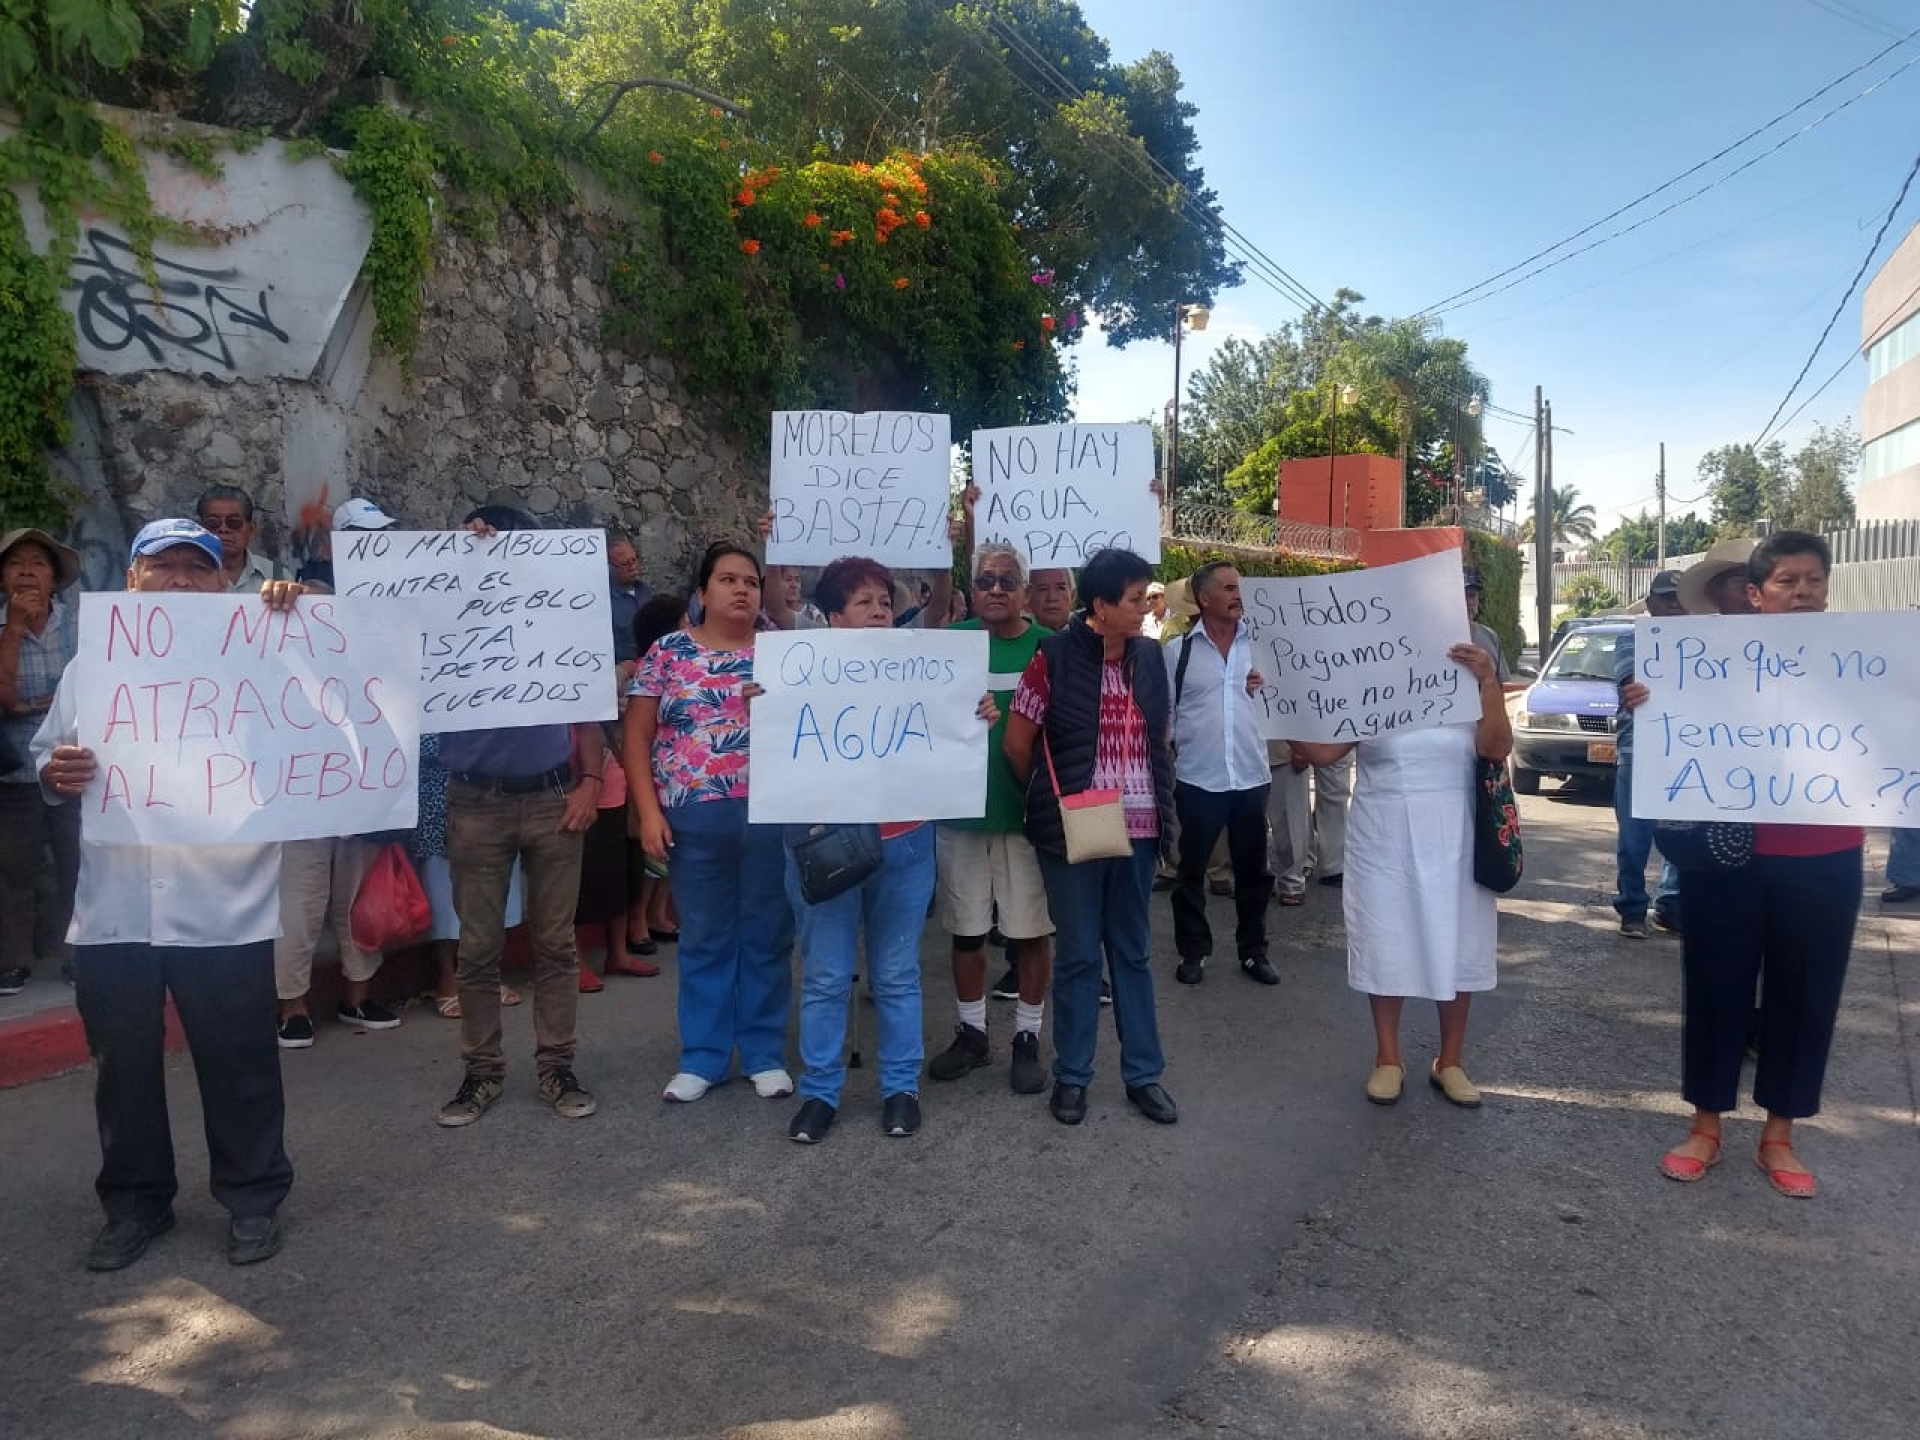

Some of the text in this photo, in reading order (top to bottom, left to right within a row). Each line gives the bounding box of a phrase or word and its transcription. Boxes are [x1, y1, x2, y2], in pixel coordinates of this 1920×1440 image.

[783, 412, 934, 459] MORELOS
[989, 427, 1119, 484] NO HAY
[803, 465, 904, 491] DICE
[770, 495, 948, 550] BASTA!!
[987, 486, 1099, 524] AGUA,
[348, 532, 600, 561] NO MAS ABUSOS
[457, 588, 596, 620] PUEBLO
[478, 571, 513, 592] EL
[1290, 585, 1392, 626] todos
[108, 602, 347, 661] NO MAS
[527, 651, 543, 668] A
[554, 647, 608, 672] LOS
[780, 641, 955, 686] Queremos
[1743, 640, 1807, 693] qué
[1831, 650, 1888, 681] no
[1363, 685, 1394, 706] no
[1407, 666, 1459, 697] hay
[103, 676, 383, 743] ATRACOS
[793, 701, 933, 762] AGUA
[102, 747, 407, 815] AL PUEBLO
